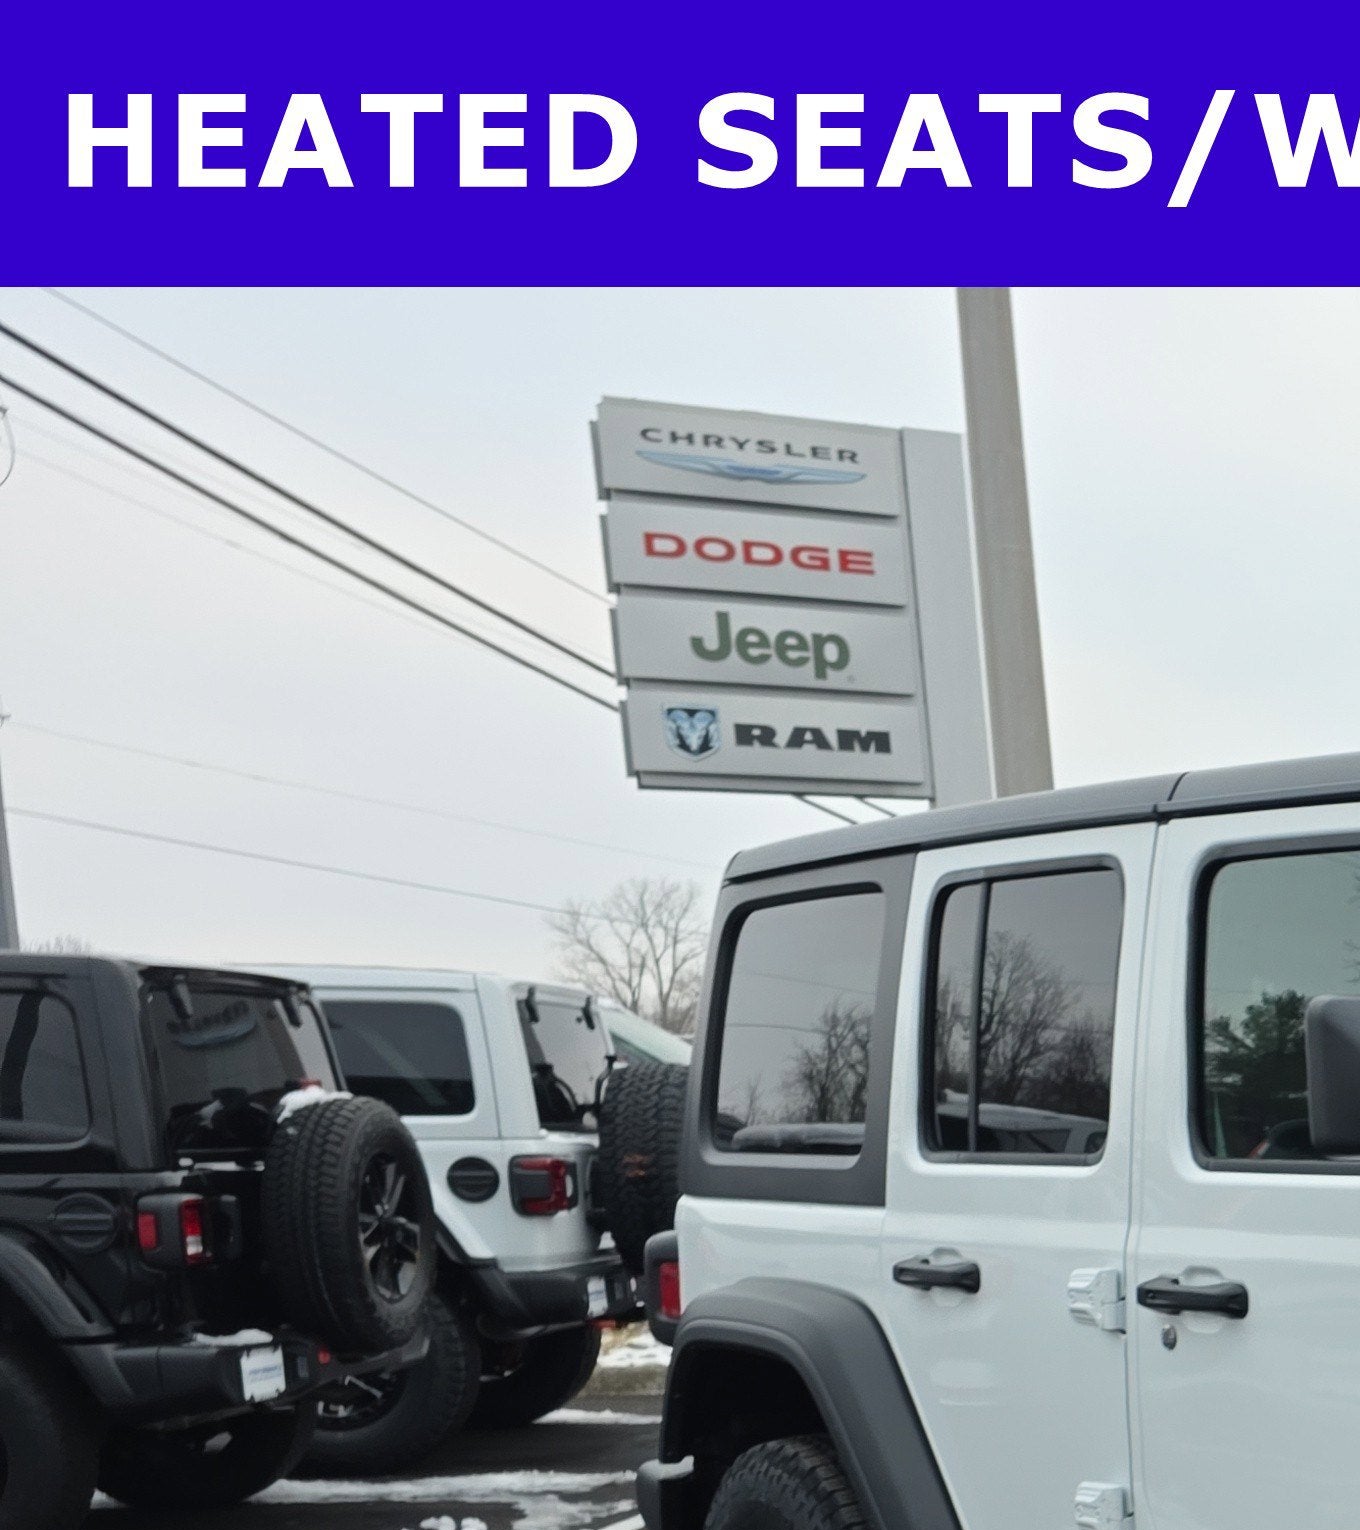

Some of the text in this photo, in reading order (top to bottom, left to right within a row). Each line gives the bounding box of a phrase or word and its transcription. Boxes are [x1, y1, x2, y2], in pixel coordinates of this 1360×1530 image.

[639, 427, 861, 465] CHRYSLER
[643, 531, 876, 576] DODGE
[690, 611, 850, 680] Jeep
[733, 722, 893, 755] RAM
